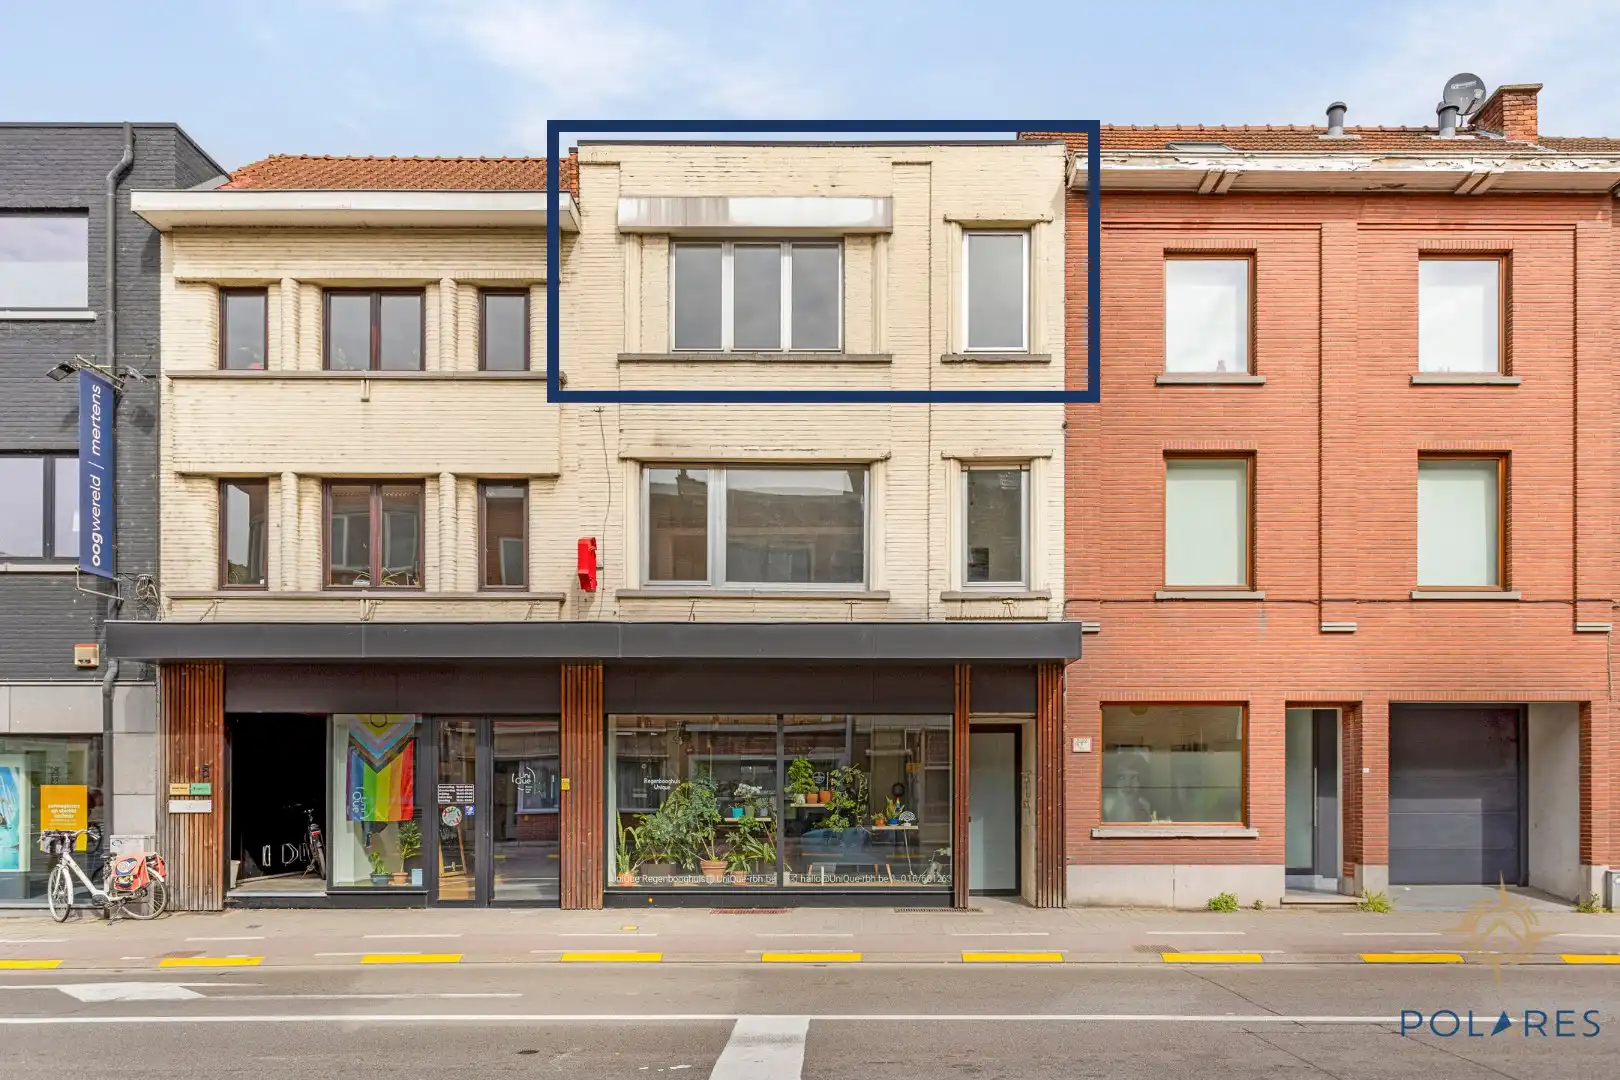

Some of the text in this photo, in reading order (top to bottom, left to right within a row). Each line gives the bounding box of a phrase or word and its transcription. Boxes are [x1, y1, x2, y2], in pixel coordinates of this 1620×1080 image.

[90, 384, 101, 456] mertens
[90, 474, 103, 566] oogwereld
[642, 874, 705, 885] Regenbooghuis
[800, 874, 889, 884] hallo@UniQue-rbhbe
